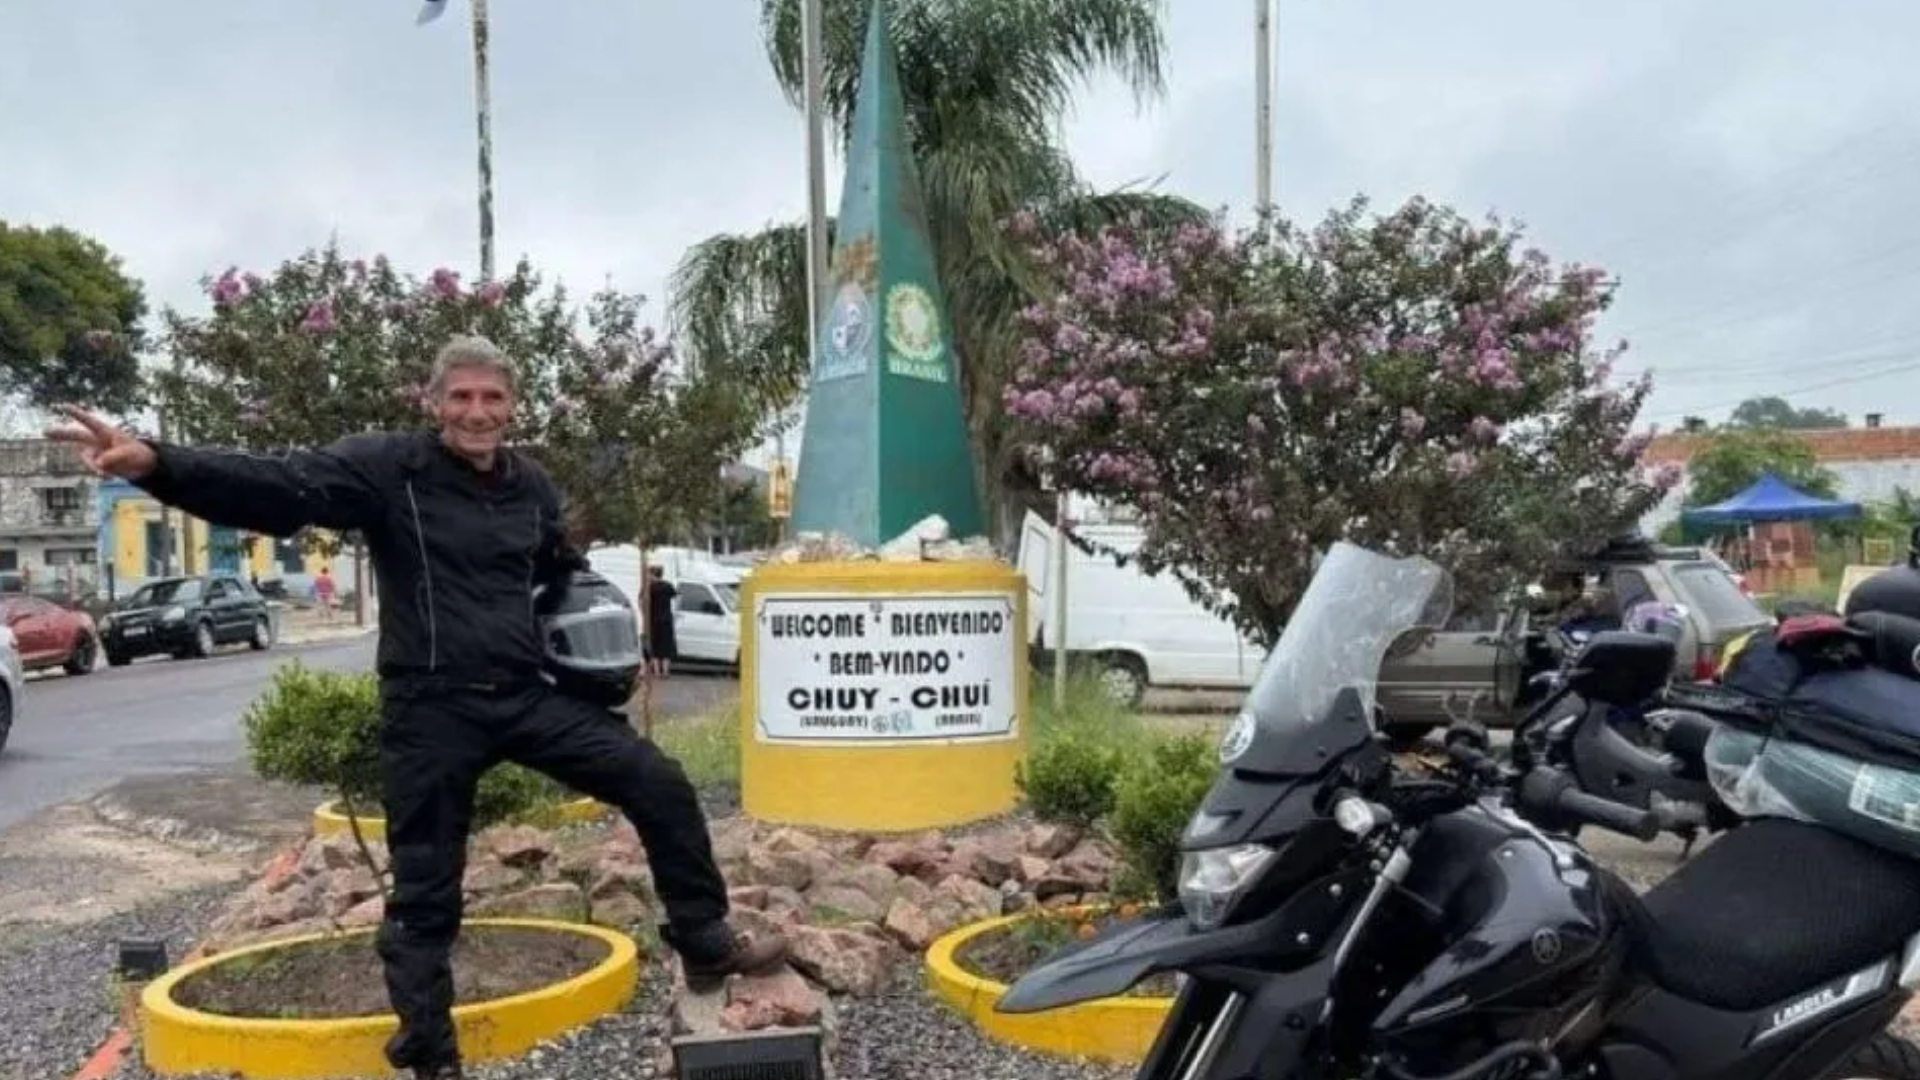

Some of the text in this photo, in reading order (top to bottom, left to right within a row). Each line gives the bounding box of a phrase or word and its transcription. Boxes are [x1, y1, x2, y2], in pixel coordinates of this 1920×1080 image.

[771, 611, 1003, 638] WELCOME BIENVENIDO
[829, 650, 950, 675] BEM-VINDO
[788, 687, 881, 711] CHUY
[910, 679, 991, 709] CHUÍ
[1774, 988, 1835, 1024] LANDER
